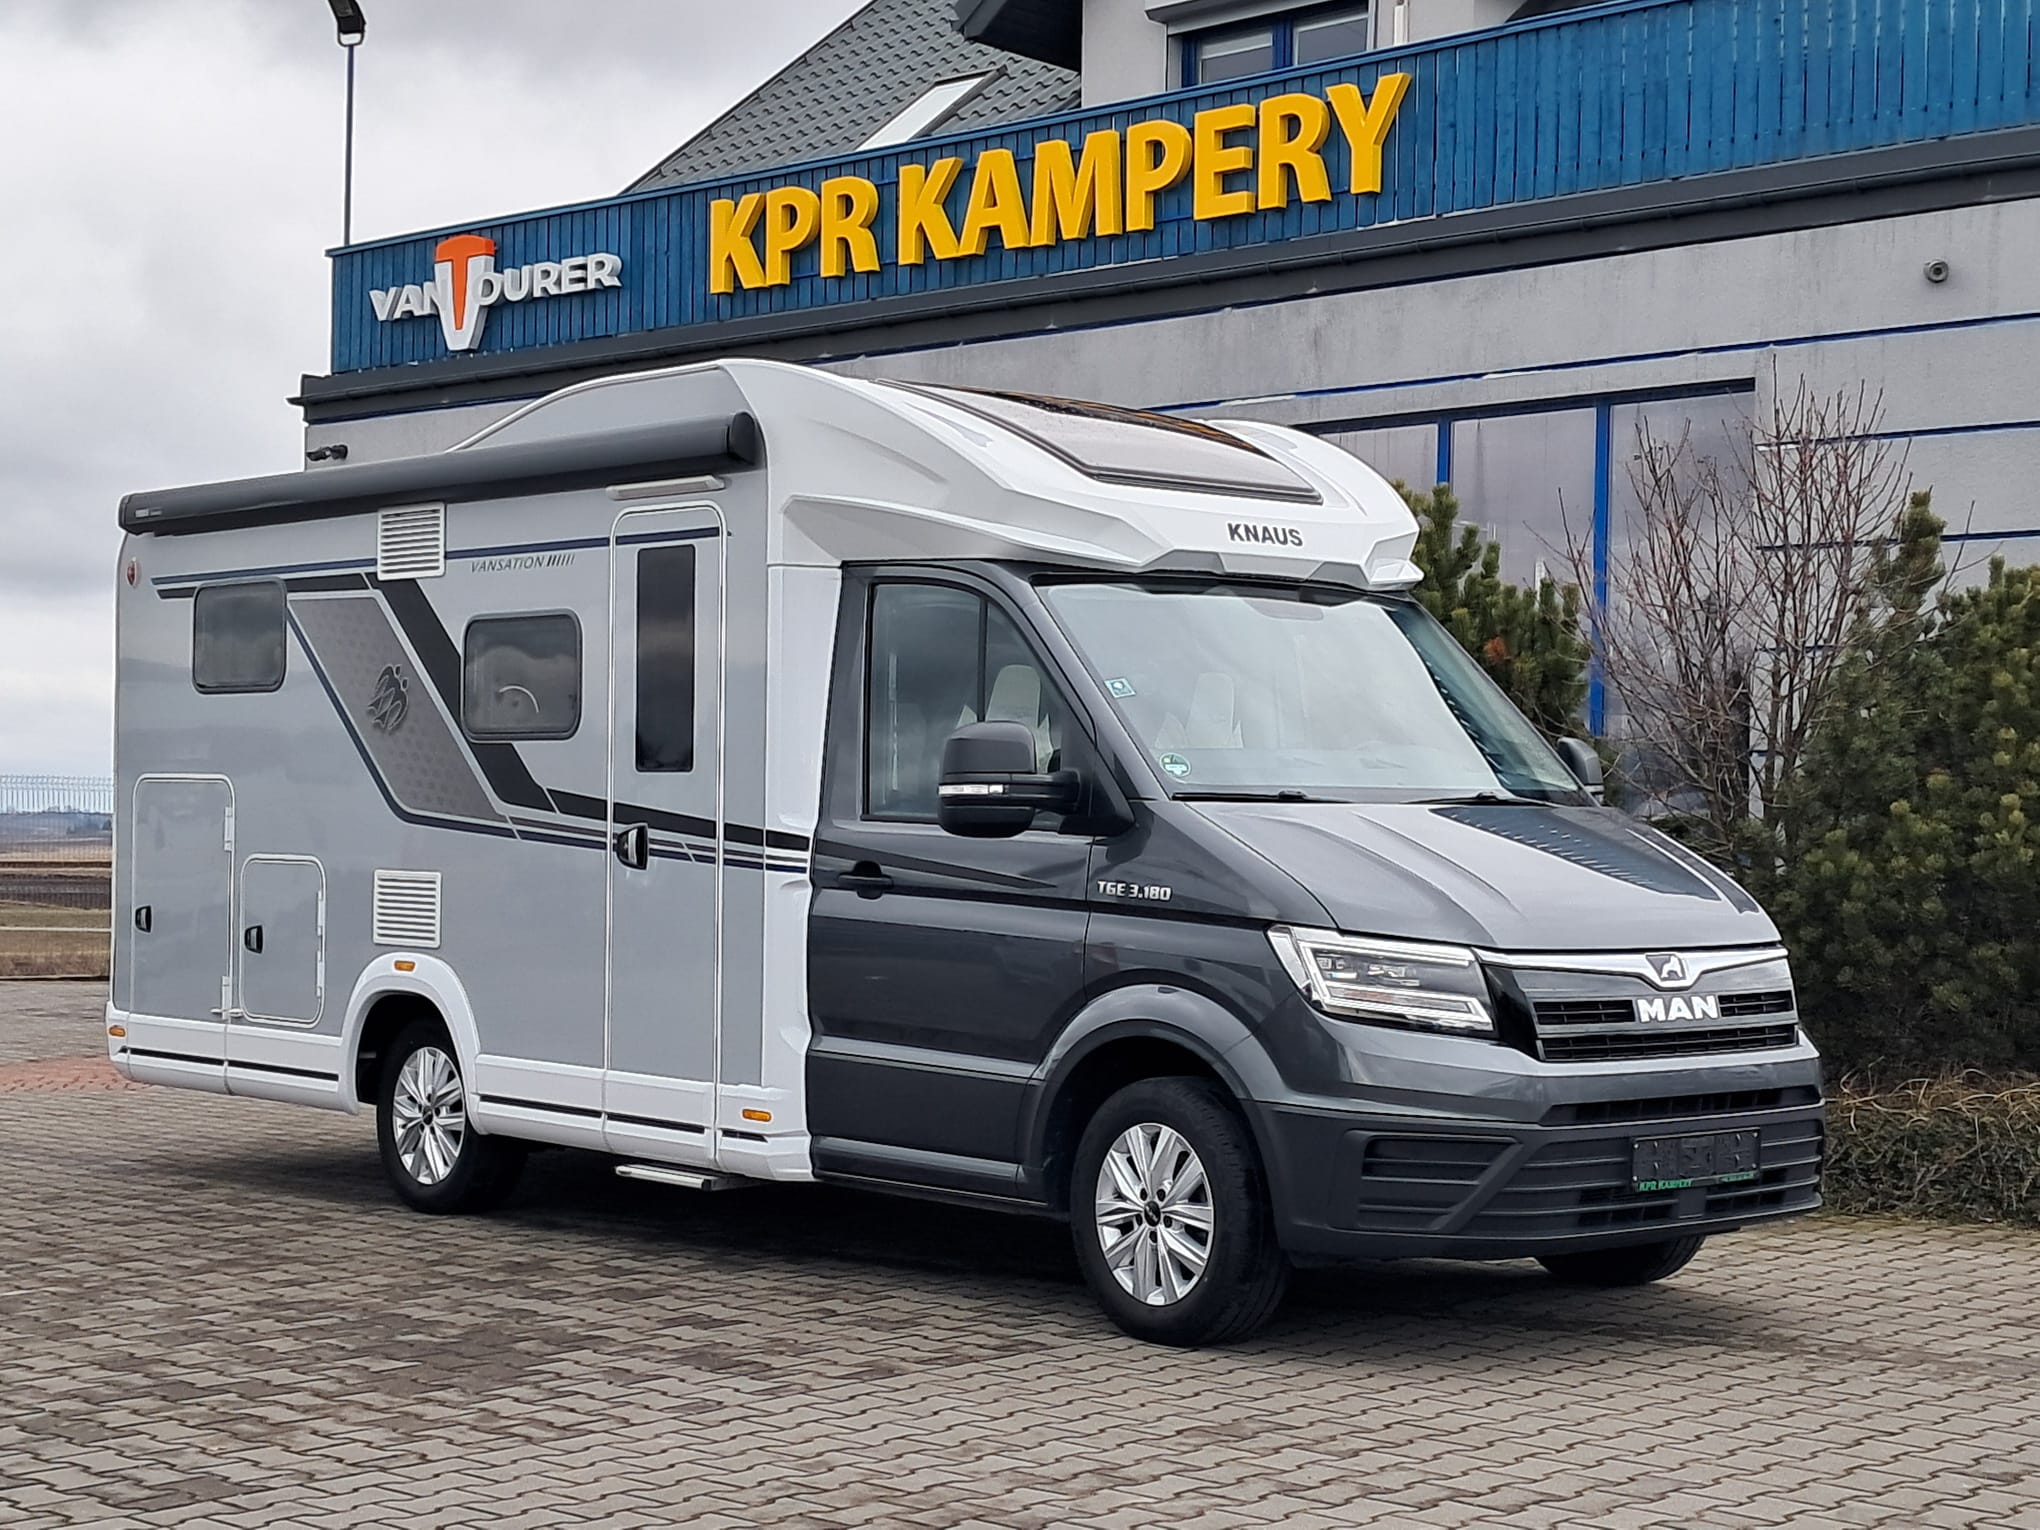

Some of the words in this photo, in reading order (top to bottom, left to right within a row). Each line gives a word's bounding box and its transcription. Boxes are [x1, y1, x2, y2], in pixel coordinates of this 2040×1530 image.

[710, 175, 880, 295] KPR
[898, 72, 1412, 266] KAMPERY
[1227, 522, 1303, 546] KNAUS
[470, 555, 545, 573] VANSATION
[1097, 880, 1127, 897] TGE
[1127, 884, 1172, 901] 3.180
[1637, 994, 1719, 1023] MAN
